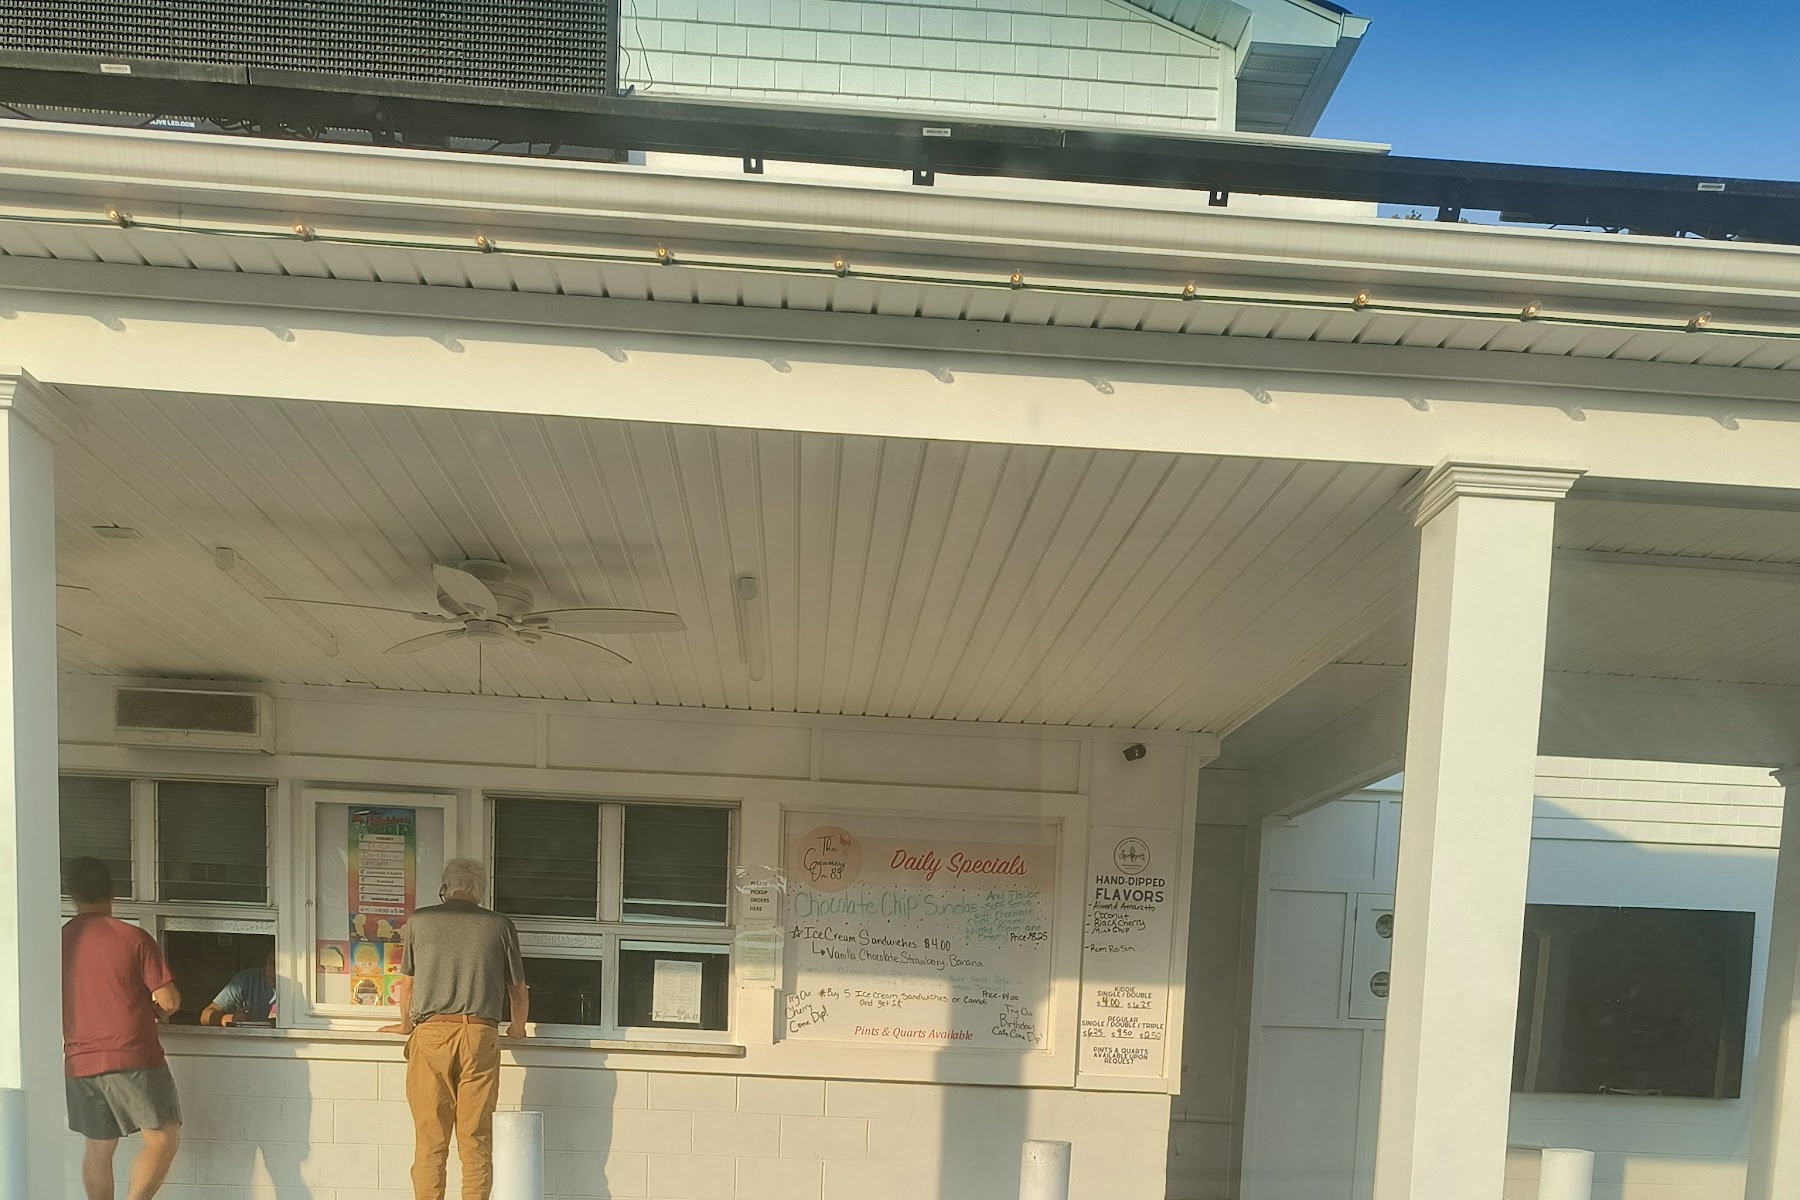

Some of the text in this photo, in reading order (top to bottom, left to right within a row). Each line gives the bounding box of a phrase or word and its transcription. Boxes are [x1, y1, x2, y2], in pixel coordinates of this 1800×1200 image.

[817, 836, 838, 856] The
[804, 848, 846, 873] Creamery
[890, 849, 1028, 882] Daily Specials
[810, 861, 842, 882] On 83
[1096, 875, 1166, 888] HAND-DIPPED
[1009, 891, 1041, 900] Flavor
[1096, 888, 1164, 903] FLAVORS
[794, 891, 978, 920] Chocolate Chip Sundae
[859, 929, 918, 949] Sandwiches
[949, 954, 984, 968] Banana
[844, 989, 851, 998] 5
[785, 1004, 813, 1020] Cherry
[1004, 1004, 1019, 1019] Try
[790, 1020, 811, 1033] Cone
[1000, 1013, 1036, 1032] Birthday
[855, 1026, 974, 1040] Pints & Quarts Available
